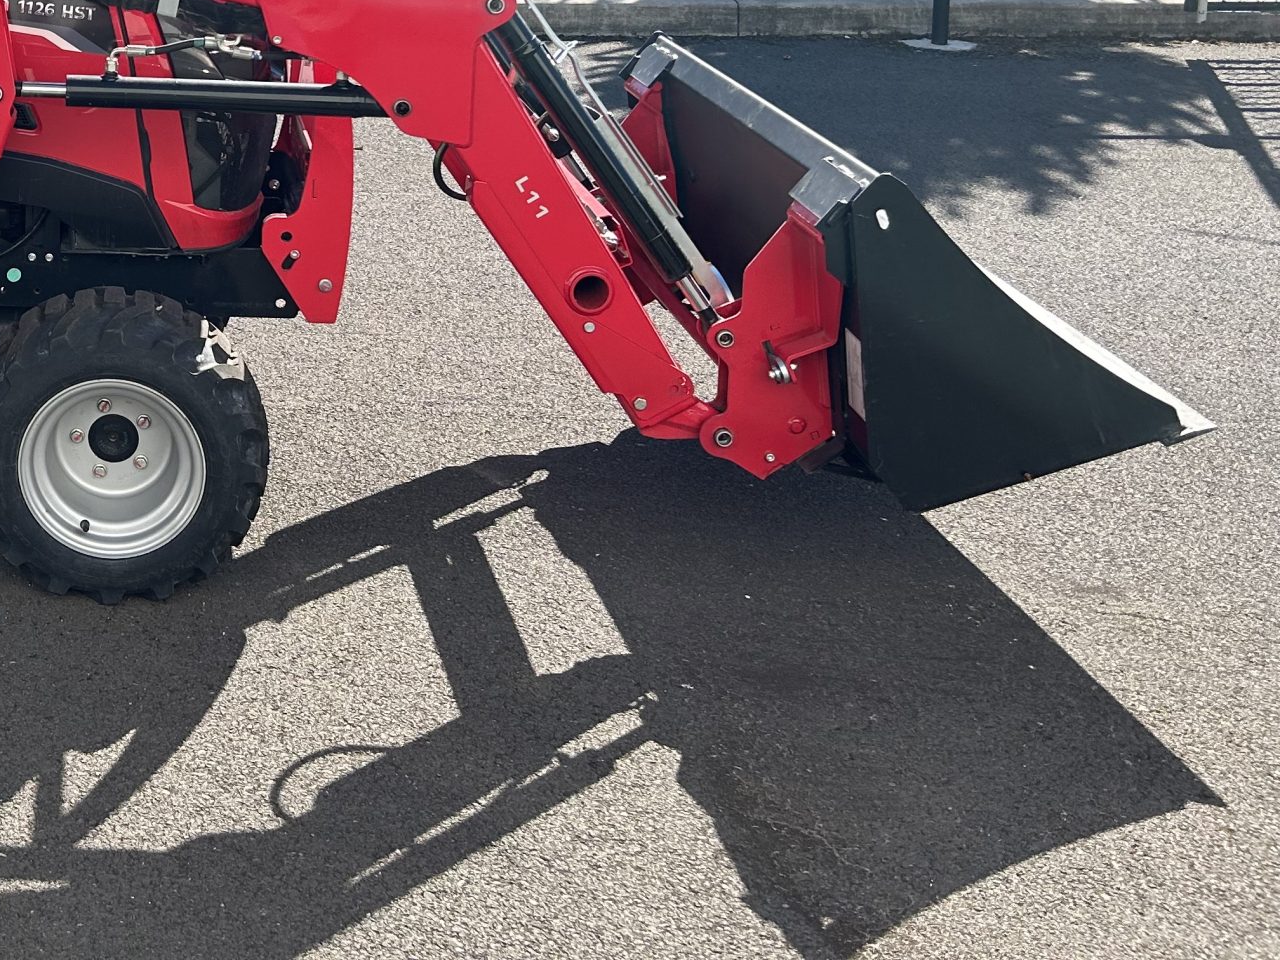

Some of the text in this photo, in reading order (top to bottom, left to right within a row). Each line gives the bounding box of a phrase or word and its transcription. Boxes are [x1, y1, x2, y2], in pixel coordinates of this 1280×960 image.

[18, 0, 96, 21] 1126 HST
[514, 175, 549, 219] L11
